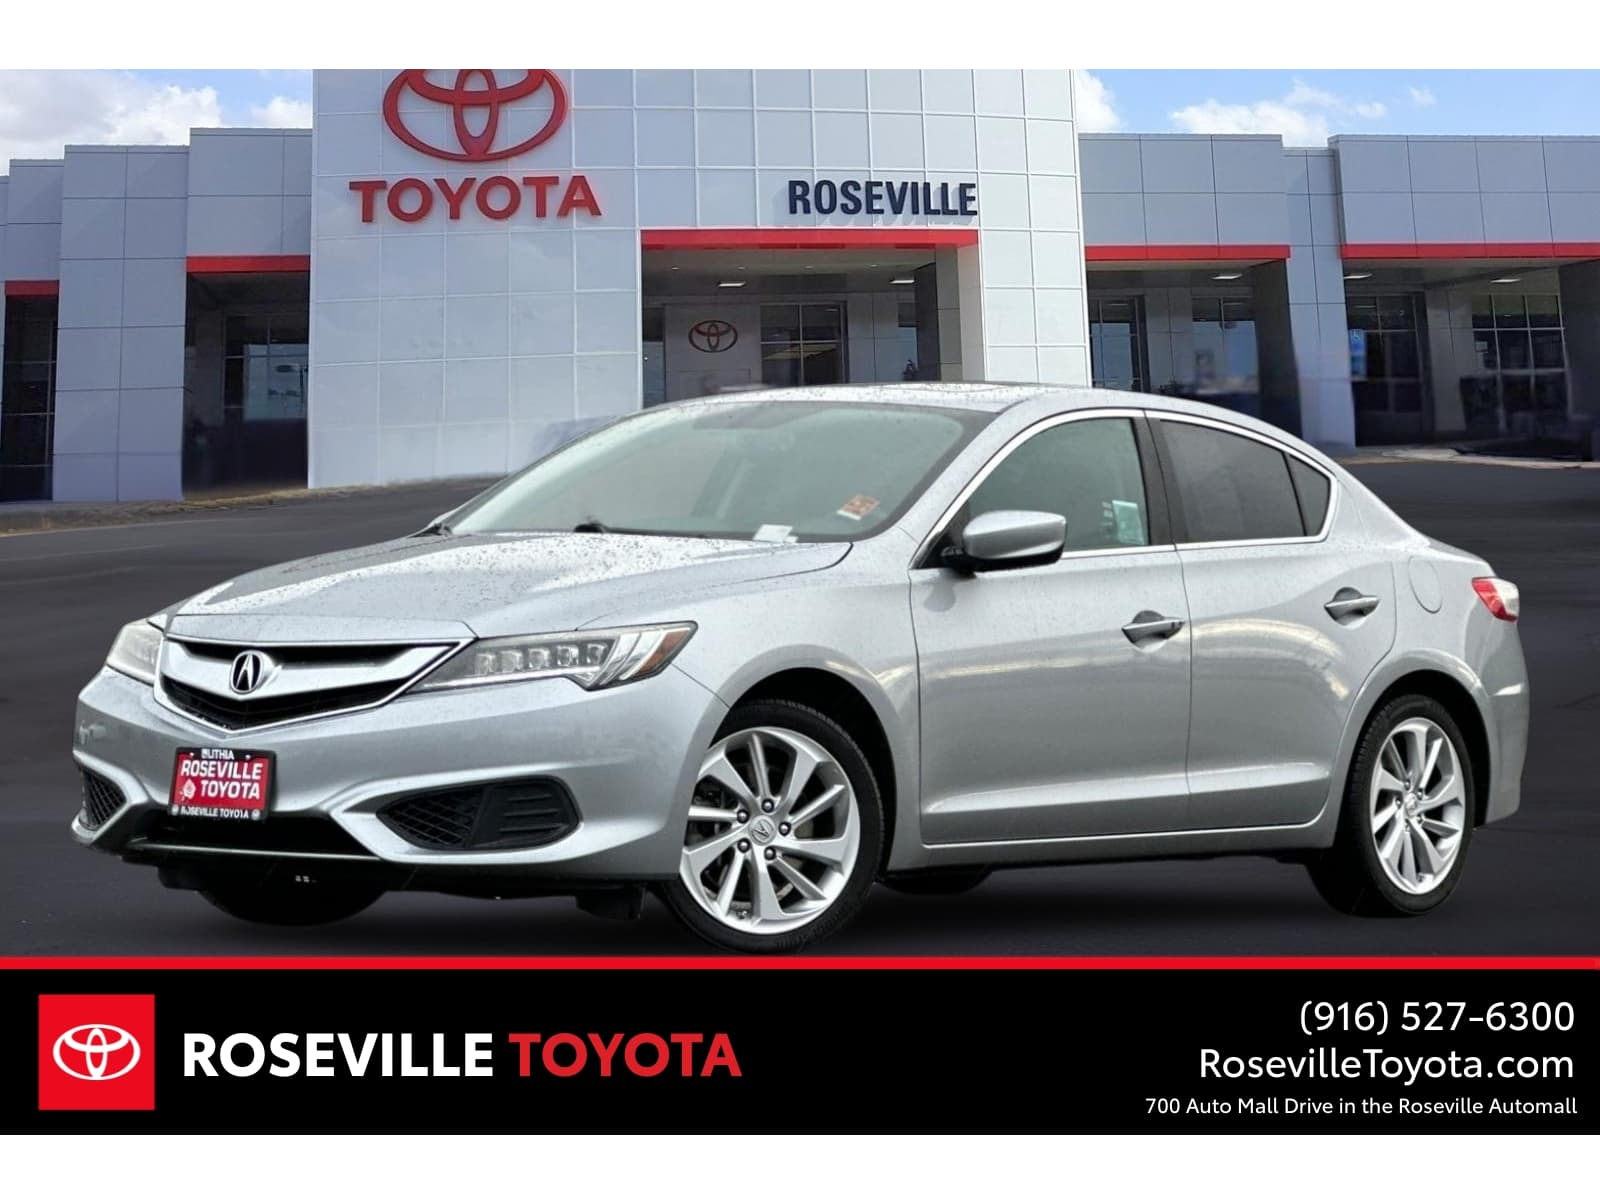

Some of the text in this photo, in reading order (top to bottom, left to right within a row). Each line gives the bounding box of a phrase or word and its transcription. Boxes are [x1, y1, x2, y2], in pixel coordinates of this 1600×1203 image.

[349, 175, 602, 223] TOYOTA
[788, 180, 979, 217] ROSEVILLE
[180, 760, 263, 780] ROSEVILLE
[200, 780, 261, 800] TOYOTA
